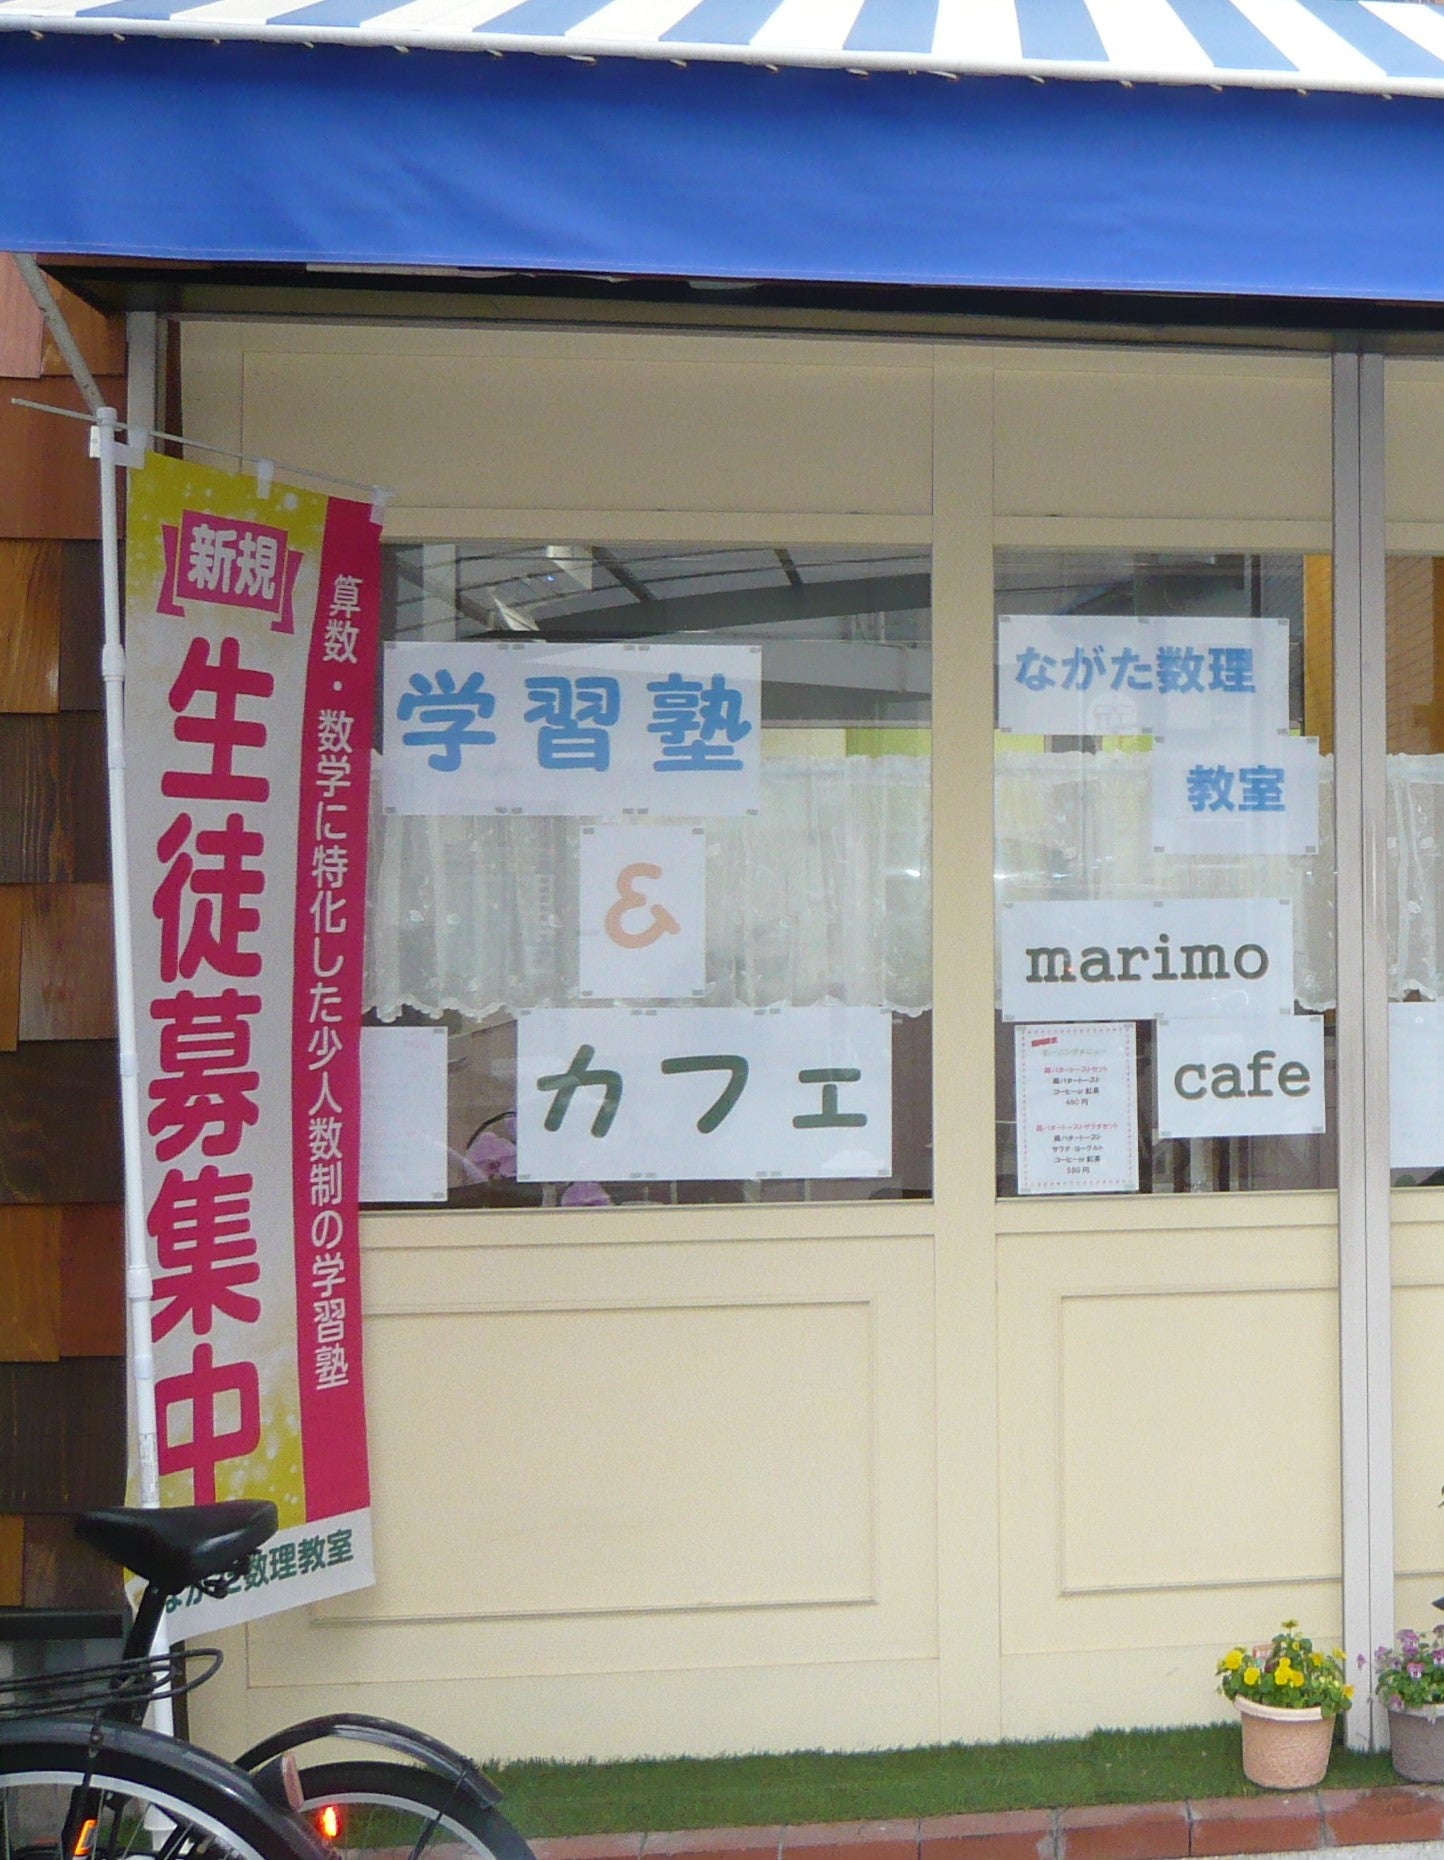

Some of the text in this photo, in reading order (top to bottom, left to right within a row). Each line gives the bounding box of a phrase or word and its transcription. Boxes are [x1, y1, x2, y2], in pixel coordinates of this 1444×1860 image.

[187, 522, 281, 601] 新規
[1016, 645, 1256, 694] ながた数理
[396, 669, 752, 772] 学習塾
[1186, 764, 1286, 813] 教室
[605, 861, 681, 949] &
[307, 574, 363, 1390] 算数・数学に特化した少人数制の学習塾
[1025, 934, 1269, 984] marimo
[147, 636, 274, 1502] 生徒募集中
[536, 1043, 868, 1138] カフェ
[1173, 1049, 1311, 1100] cafe
[166, 1528, 354, 1613] 数理教室
